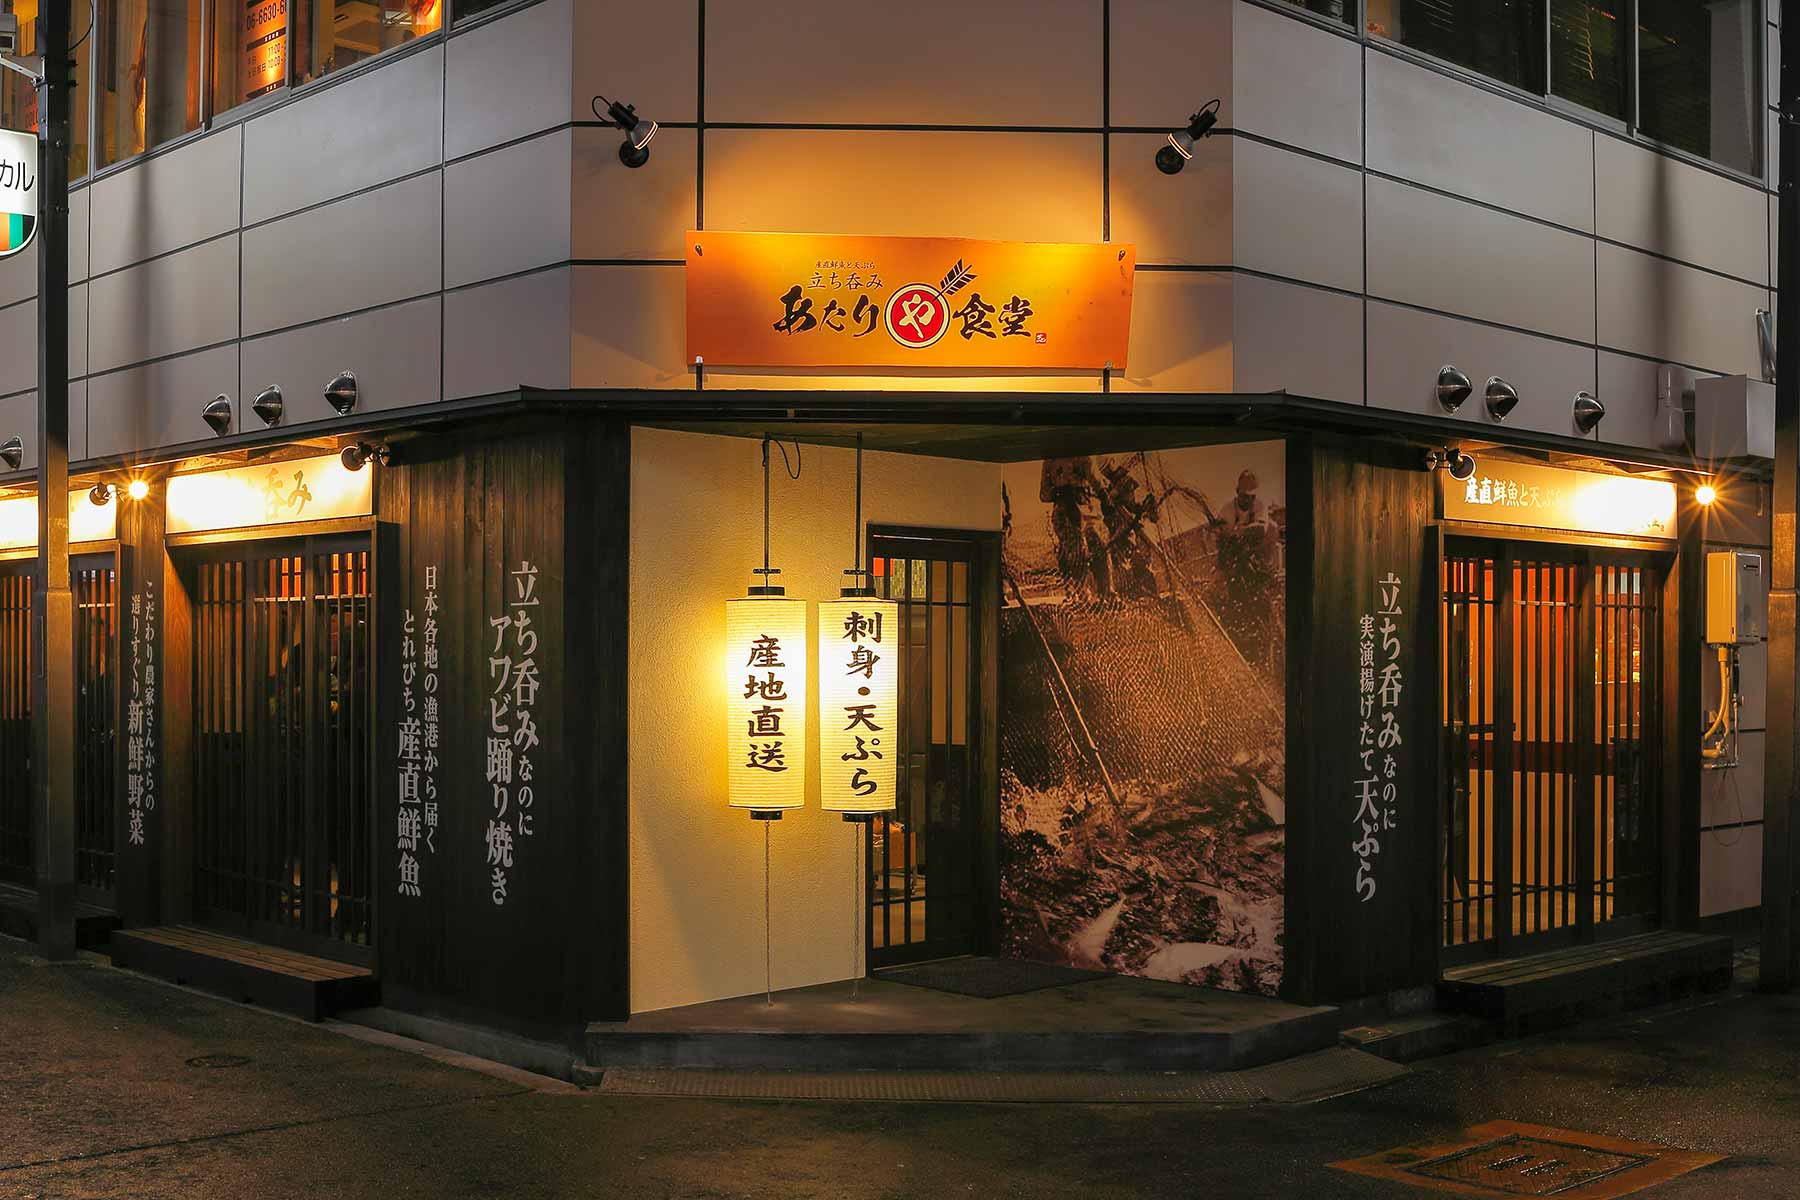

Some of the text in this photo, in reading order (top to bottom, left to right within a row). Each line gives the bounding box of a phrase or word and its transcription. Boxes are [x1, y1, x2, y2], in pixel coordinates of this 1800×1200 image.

[808, 272, 883, 291] 立ち呑み
[128, 594, 145, 845] 選りすぐり新鮮野菜
[144, 580, 155, 811] こだわり農家さんからの
[397, 608, 422, 897] とれぴち産直鮮魚
[423, 565, 439, 854] 日本各地の漁港から届く
[485, 615, 515, 906] アワビ踊り焼き
[510, 560, 541, 836] 立ち呑みなのに
[743, 634, 788, 773] 産地直送
[841, 611, 884, 797] 刺身・天ぷら
[1352, 614, 1380, 903] 実演揚げたて天ぷら
[1377, 572, 1402, 831] 立ち呑みなのに
